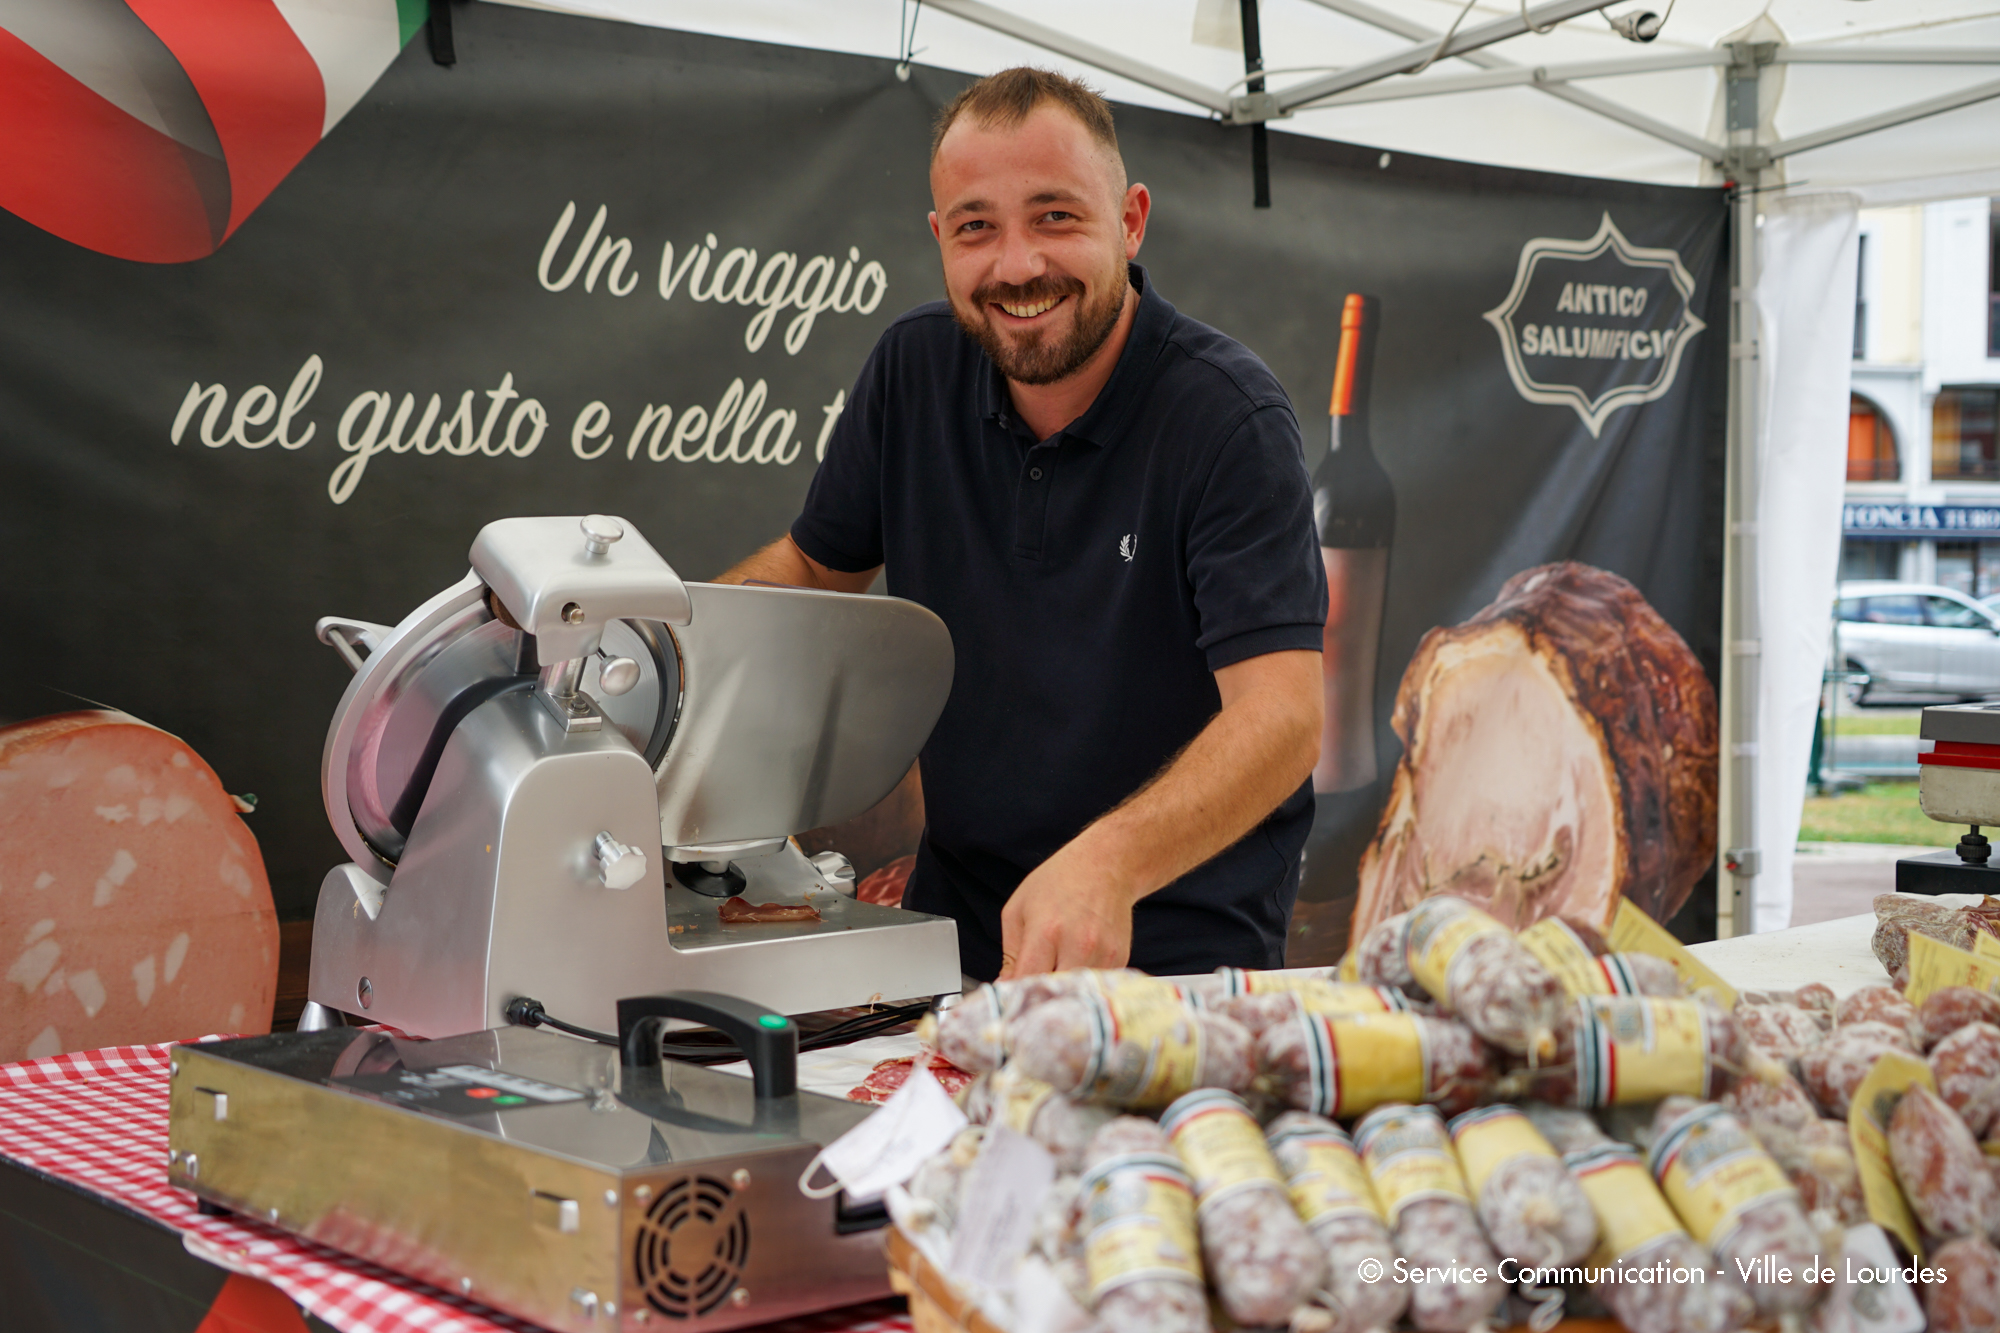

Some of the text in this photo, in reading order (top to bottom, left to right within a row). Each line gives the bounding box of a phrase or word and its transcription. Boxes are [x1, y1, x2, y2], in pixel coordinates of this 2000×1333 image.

[538, 200, 889, 356] Un viaggio
[1556, 281, 1648, 318] ANTICO
[170, 353, 323, 451] nel
[328, 371, 550, 505] gusto
[571, 400, 614, 461] e
[627, 377, 802, 466] nella
